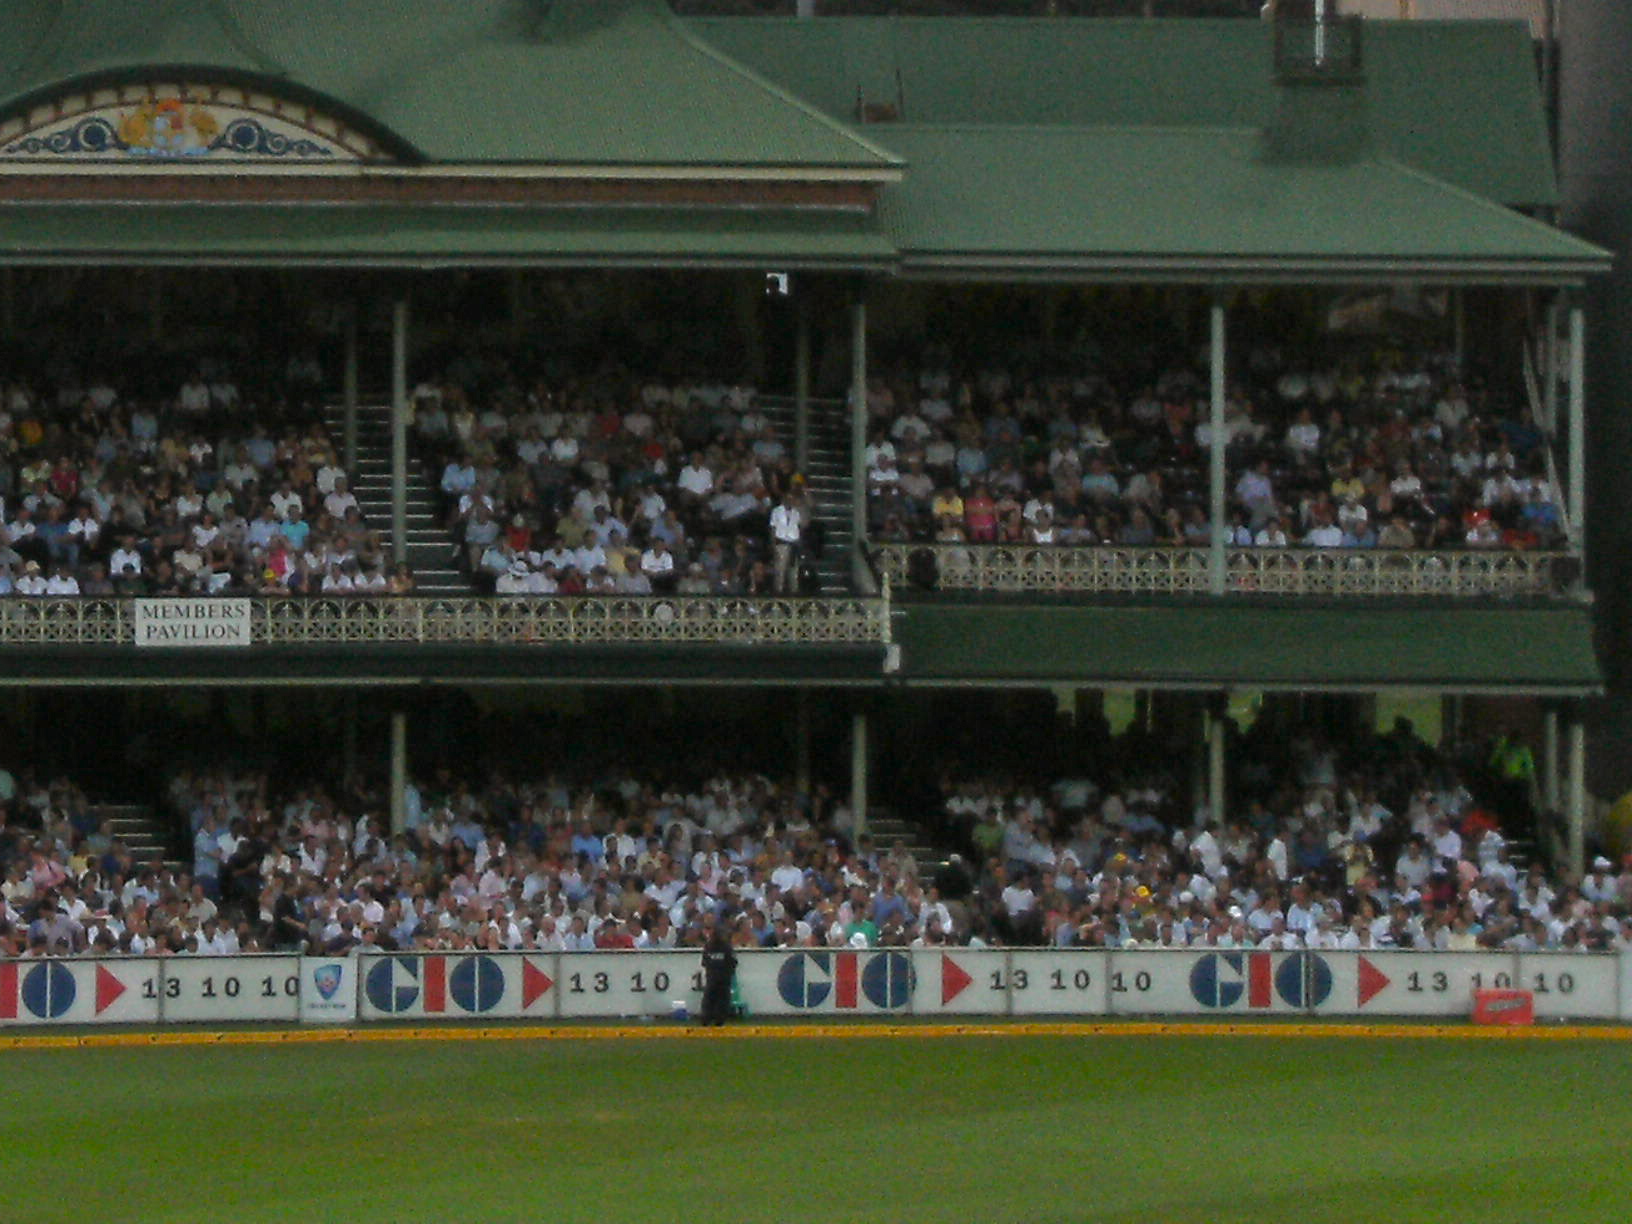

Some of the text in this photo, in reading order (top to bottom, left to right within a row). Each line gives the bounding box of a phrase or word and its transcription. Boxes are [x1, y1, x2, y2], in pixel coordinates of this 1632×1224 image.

[142, 603, 246, 619] MEMBERS
[146, 622, 241, 640] PAVILION
[143, 976, 300, 1000] 13 10 10
[366, 956, 506, 1014] GIO
[570, 972, 609, 993] 13
[631, 972, 669, 993] 10
[777, 953, 917, 1009] GIO
[990, 969, 1152, 993] 13 10 10
[1189, 955, 1334, 1009] GIO
[1408, 971, 1449, 992] 13
[1534, 973, 1574, 993] 10
